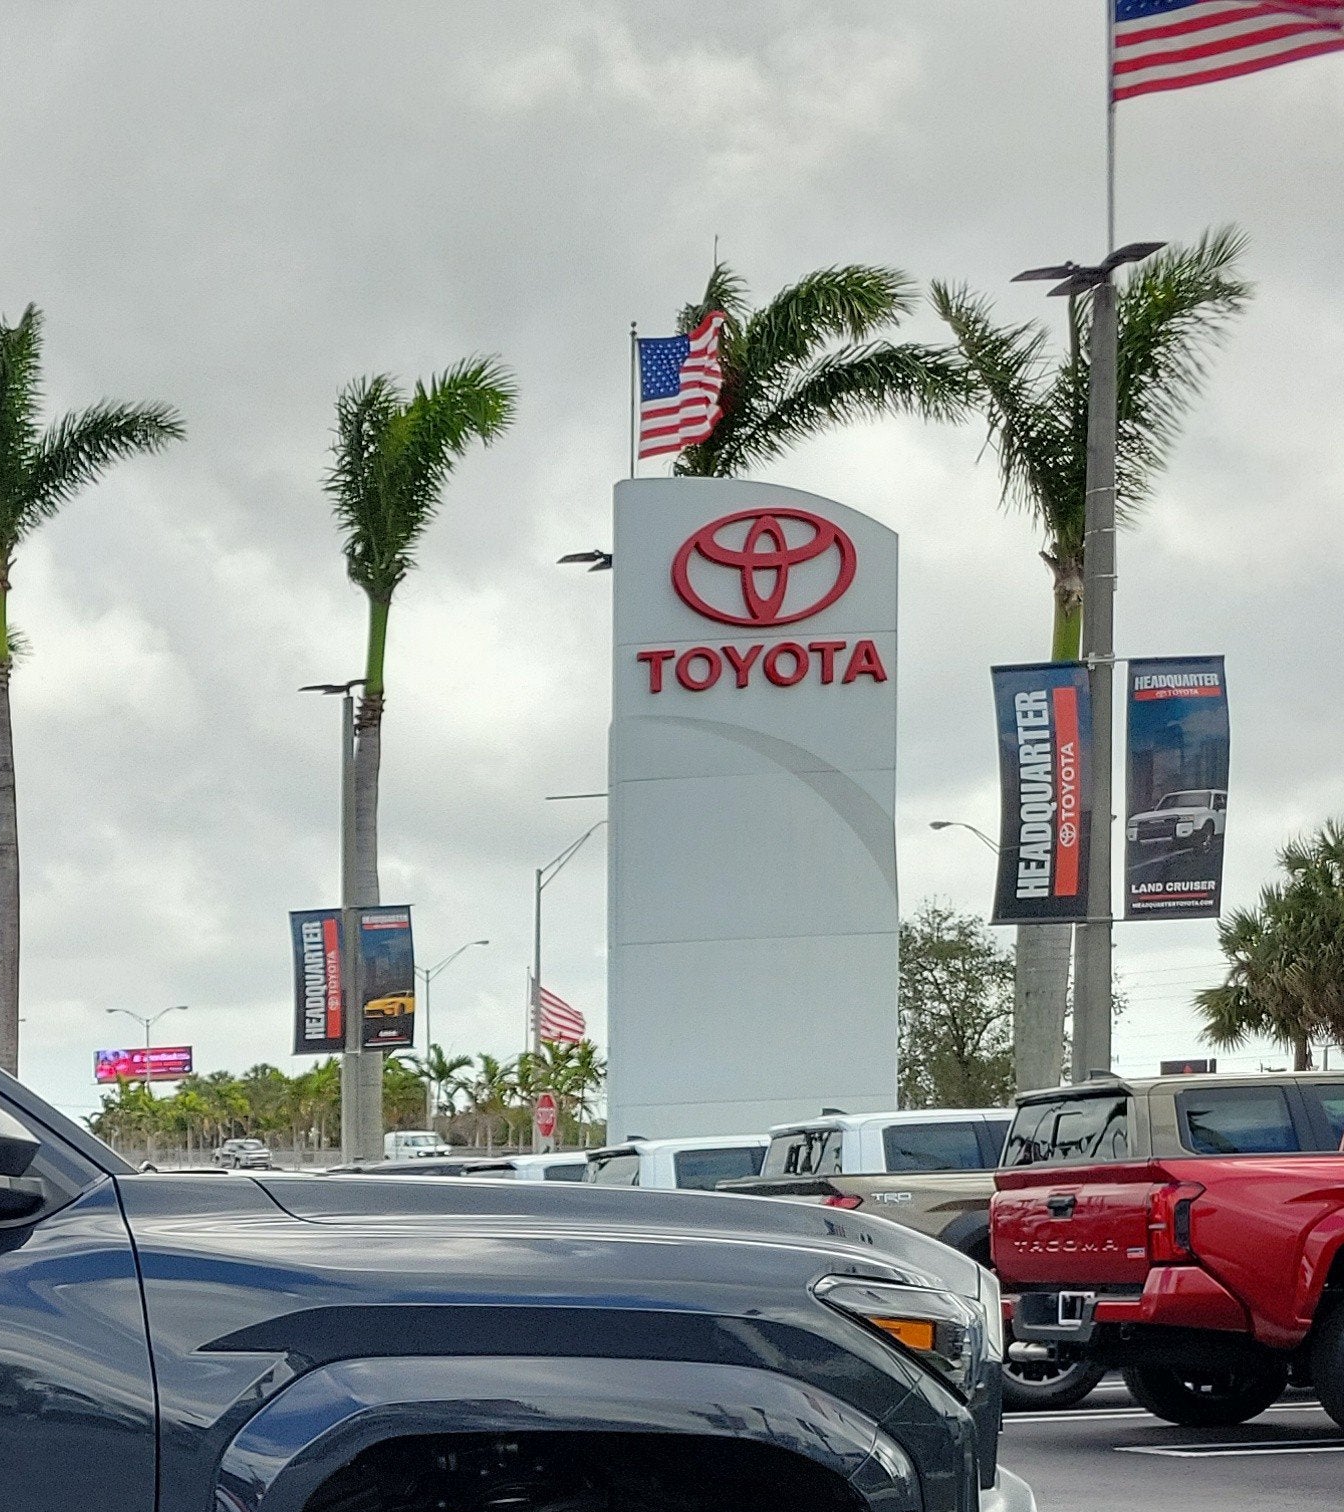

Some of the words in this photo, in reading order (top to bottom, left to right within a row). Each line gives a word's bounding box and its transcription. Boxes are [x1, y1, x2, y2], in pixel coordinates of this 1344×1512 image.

[637, 640, 887, 693] TOYOTA
[1134, 673, 1220, 690] HEADQUARTER
[1167, 687, 1199, 696] TOYOTA
[1061, 742, 1075, 820] TOYOTA
[1015, 689, 1058, 898] HEADQUARTER
[1132, 883, 1163, 893] LAND
[1165, 881, 1216, 892] CRUISER
[302, 921, 327, 1039] HEADQUARTER
[871, 1192, 912, 1203] TRD
[1014, 1239, 1118, 1253] TACOMA
